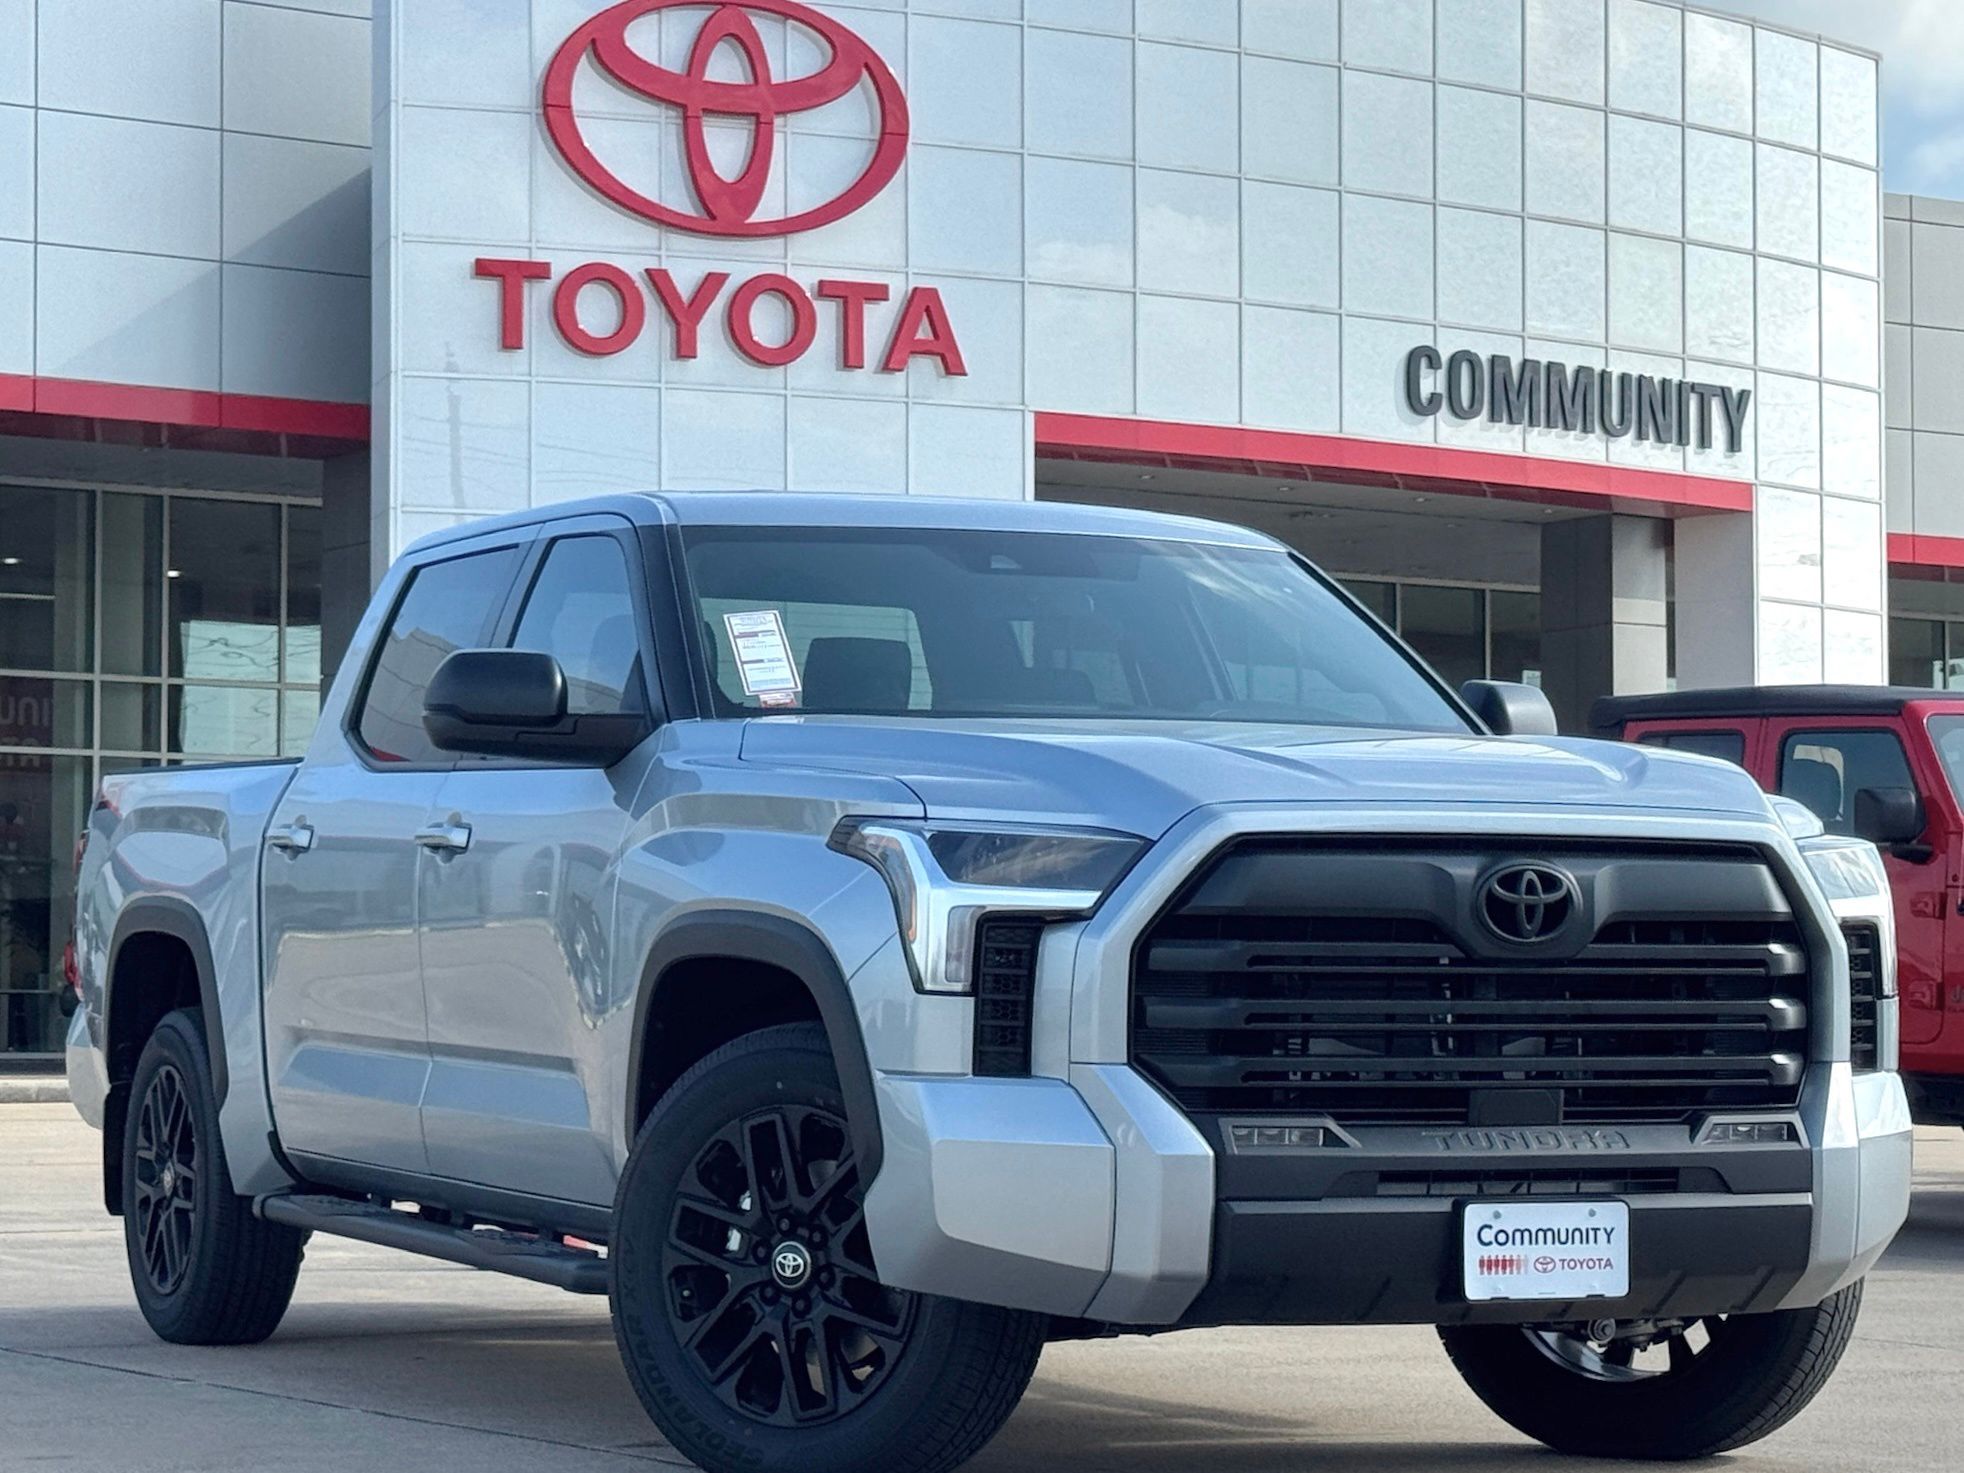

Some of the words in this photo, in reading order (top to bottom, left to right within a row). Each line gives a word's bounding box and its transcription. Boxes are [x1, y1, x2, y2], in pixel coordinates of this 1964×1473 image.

[474, 258, 968, 377] TOYOTA
[1405, 344, 1752, 453] COMMUNITY
[1421, 1130, 1631, 1150] TUNDRA
[1559, 1257, 1614, 1271] TOYOTA
